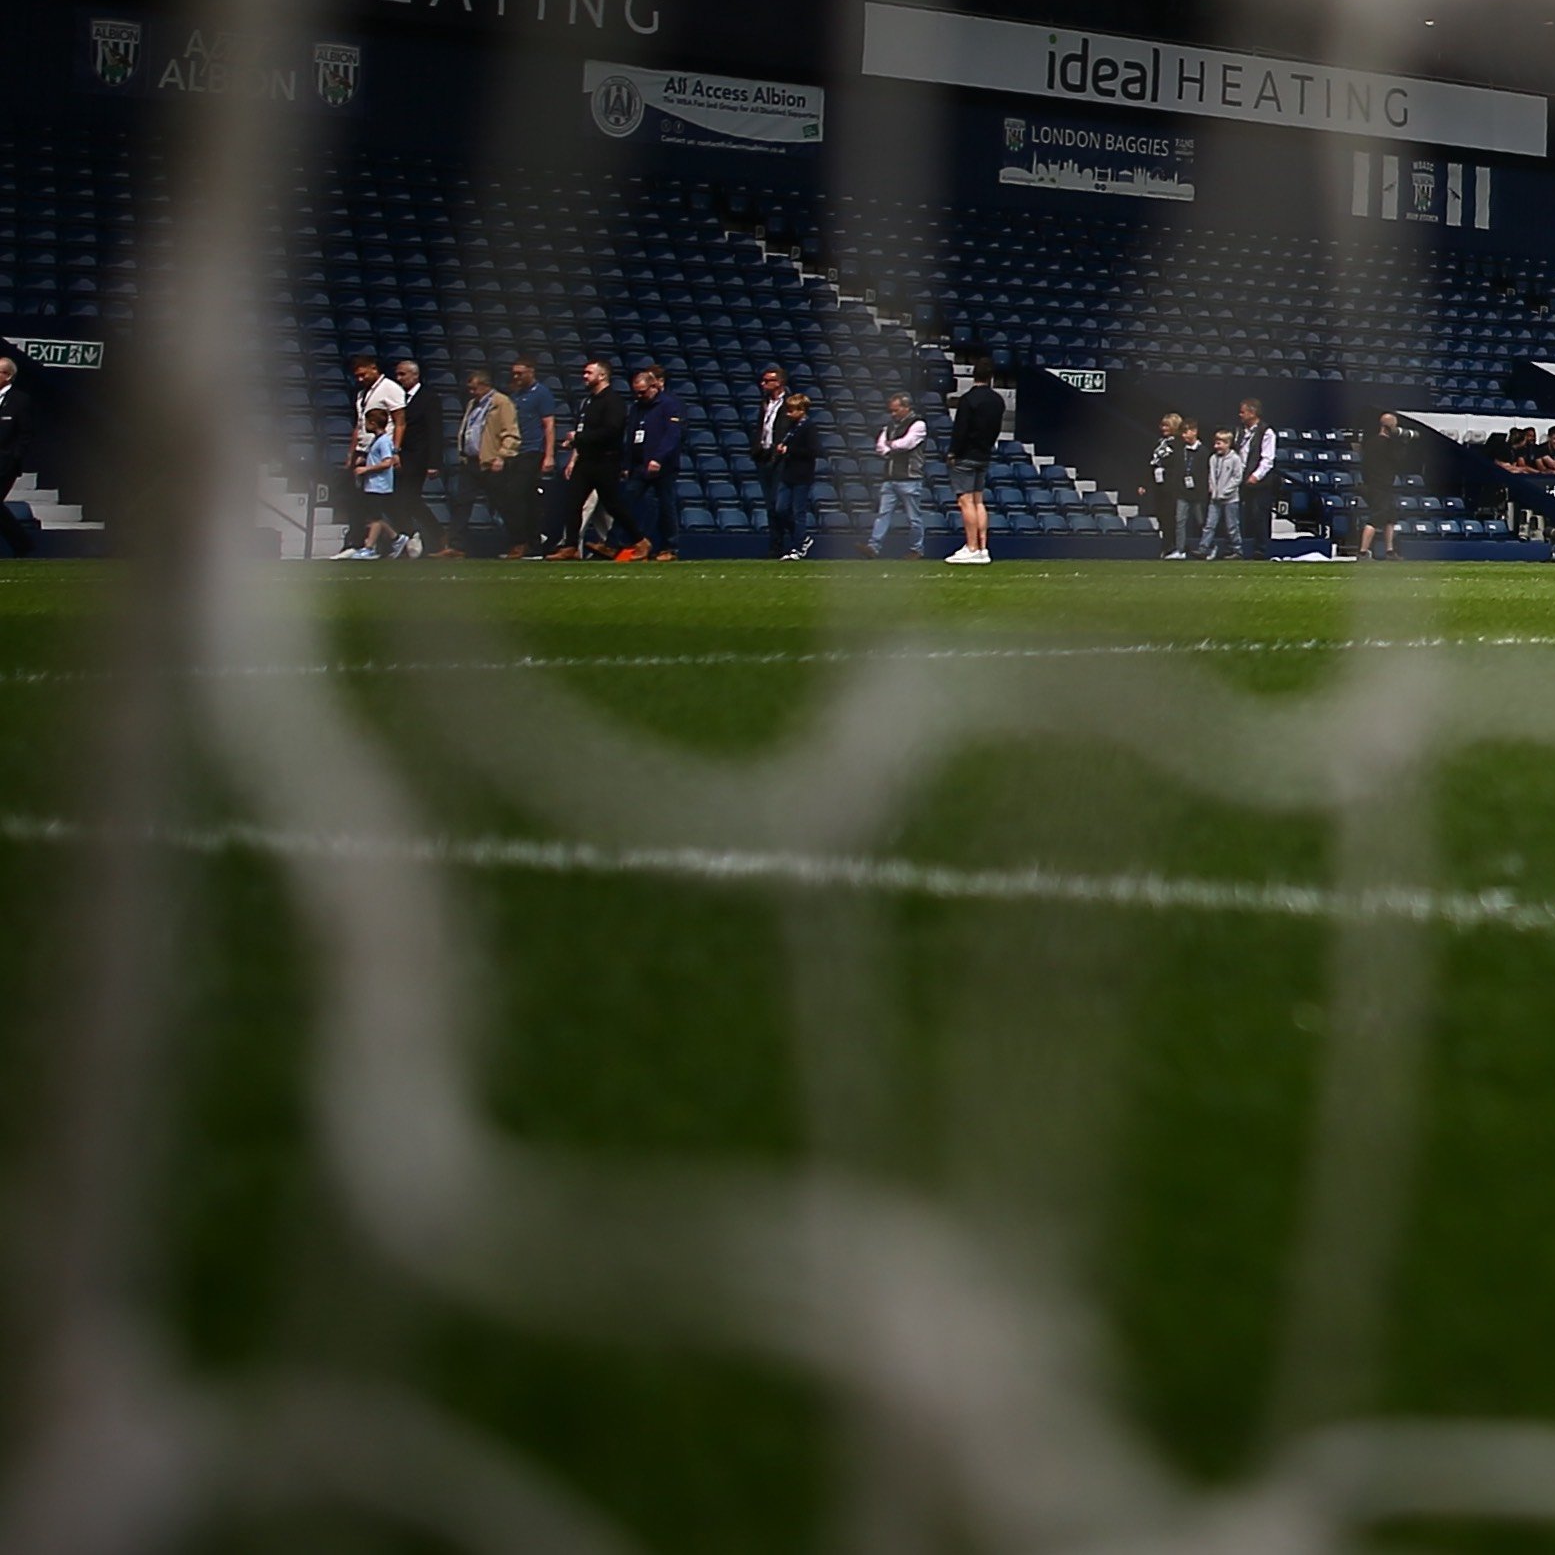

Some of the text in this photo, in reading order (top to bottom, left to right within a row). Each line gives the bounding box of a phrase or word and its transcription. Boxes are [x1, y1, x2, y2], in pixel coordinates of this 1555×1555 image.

[94, 27, 139, 42] ALBION
[317, 50, 358, 65] ALBION
[663, 77, 806, 108] All Access Albion
[1046, 33, 1409, 128] ideal HEATING
[1031, 124, 1100, 150] LONDON
[1105, 133, 1169, 157] BAGGIES
[27, 343, 67, 362] EXIT
